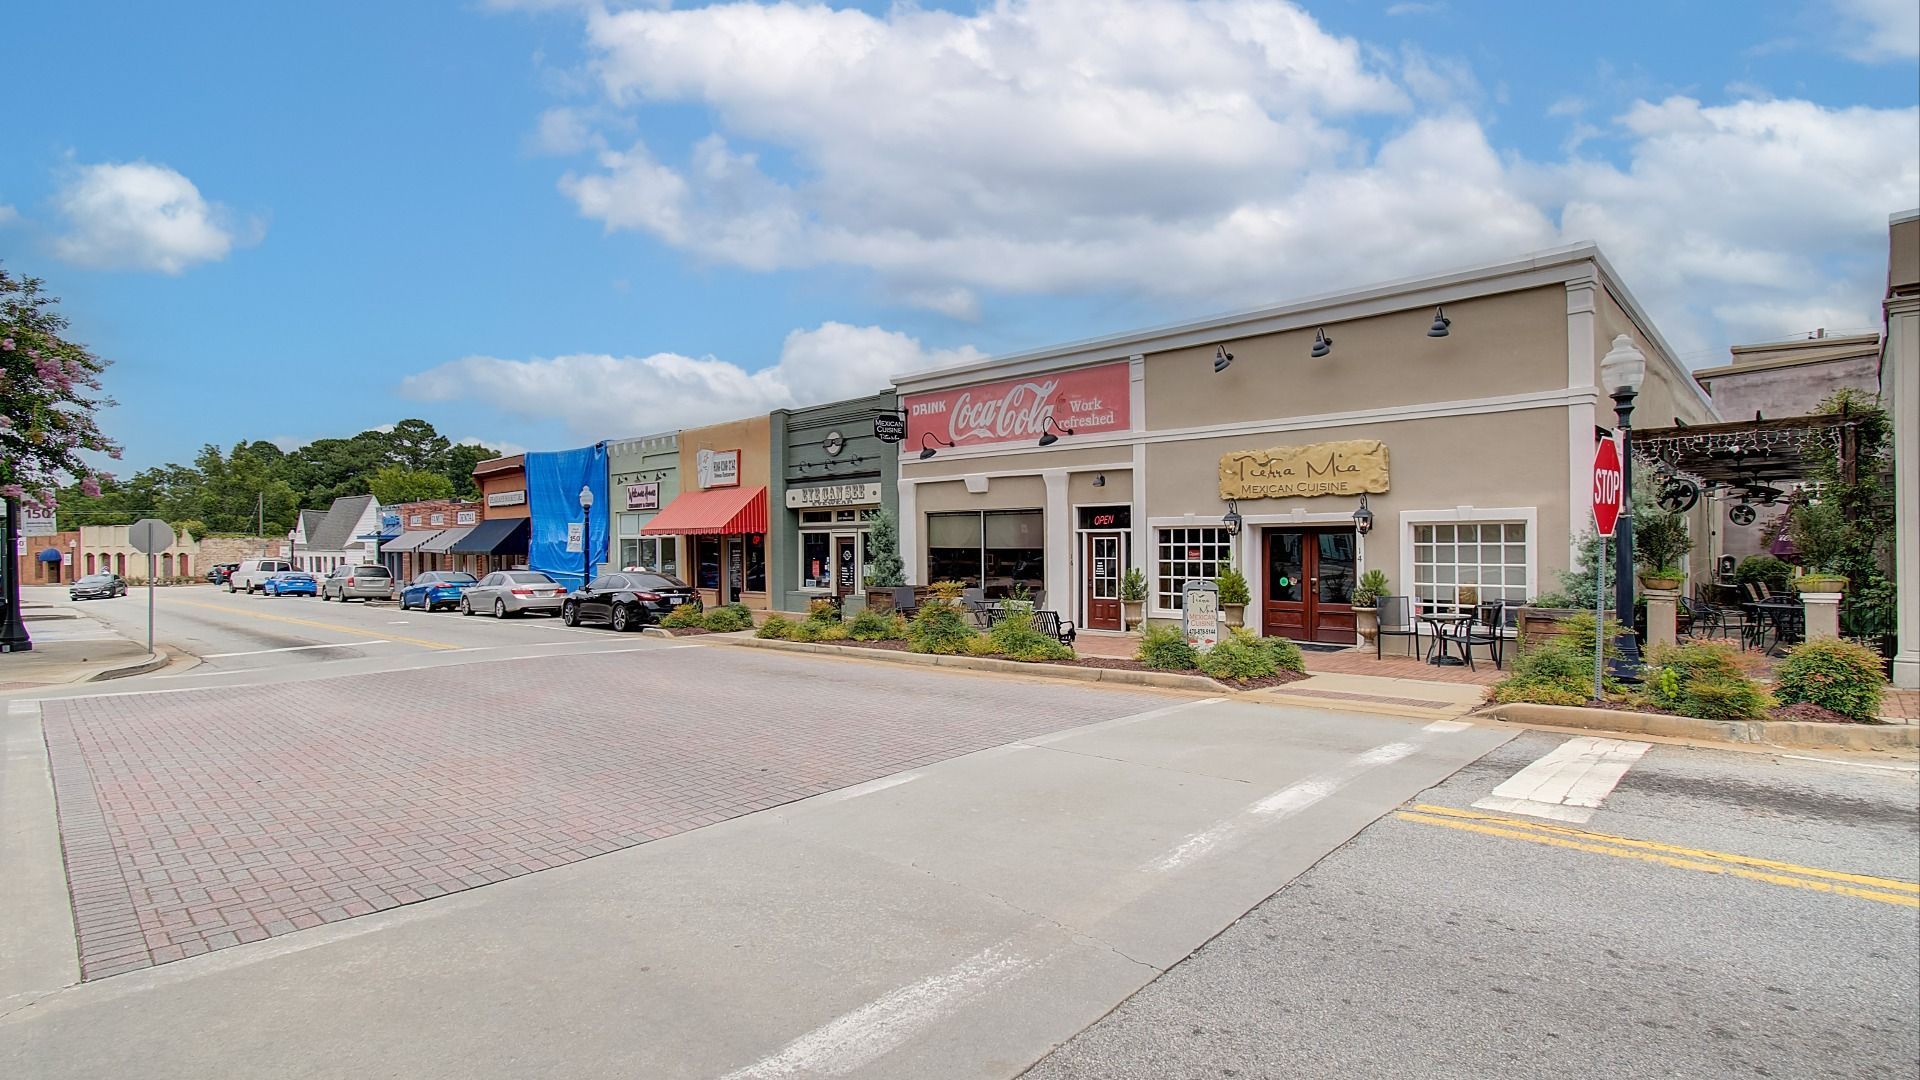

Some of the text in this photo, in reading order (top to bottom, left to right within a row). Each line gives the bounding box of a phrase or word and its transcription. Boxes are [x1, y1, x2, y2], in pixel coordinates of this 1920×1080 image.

[912, 378, 1060, 441] DRINK Coca-Cola
[1069, 397, 1103, 412] Work
[875, 419, 903, 427] MEXICAN
[1059, 411, 1115, 429] refreshed
[876, 426, 902, 434] CUISINE
[1233, 452, 1360, 481] Tierra Mia
[802, 483, 865, 503] EYE CAN SEE
[1241, 481, 1348, 494] MEXICAN CUISINE
[1595, 468, 1620, 505] STOP
[24, 509, 50, 519] 150
[1094, 515, 1114, 525] OPEN
